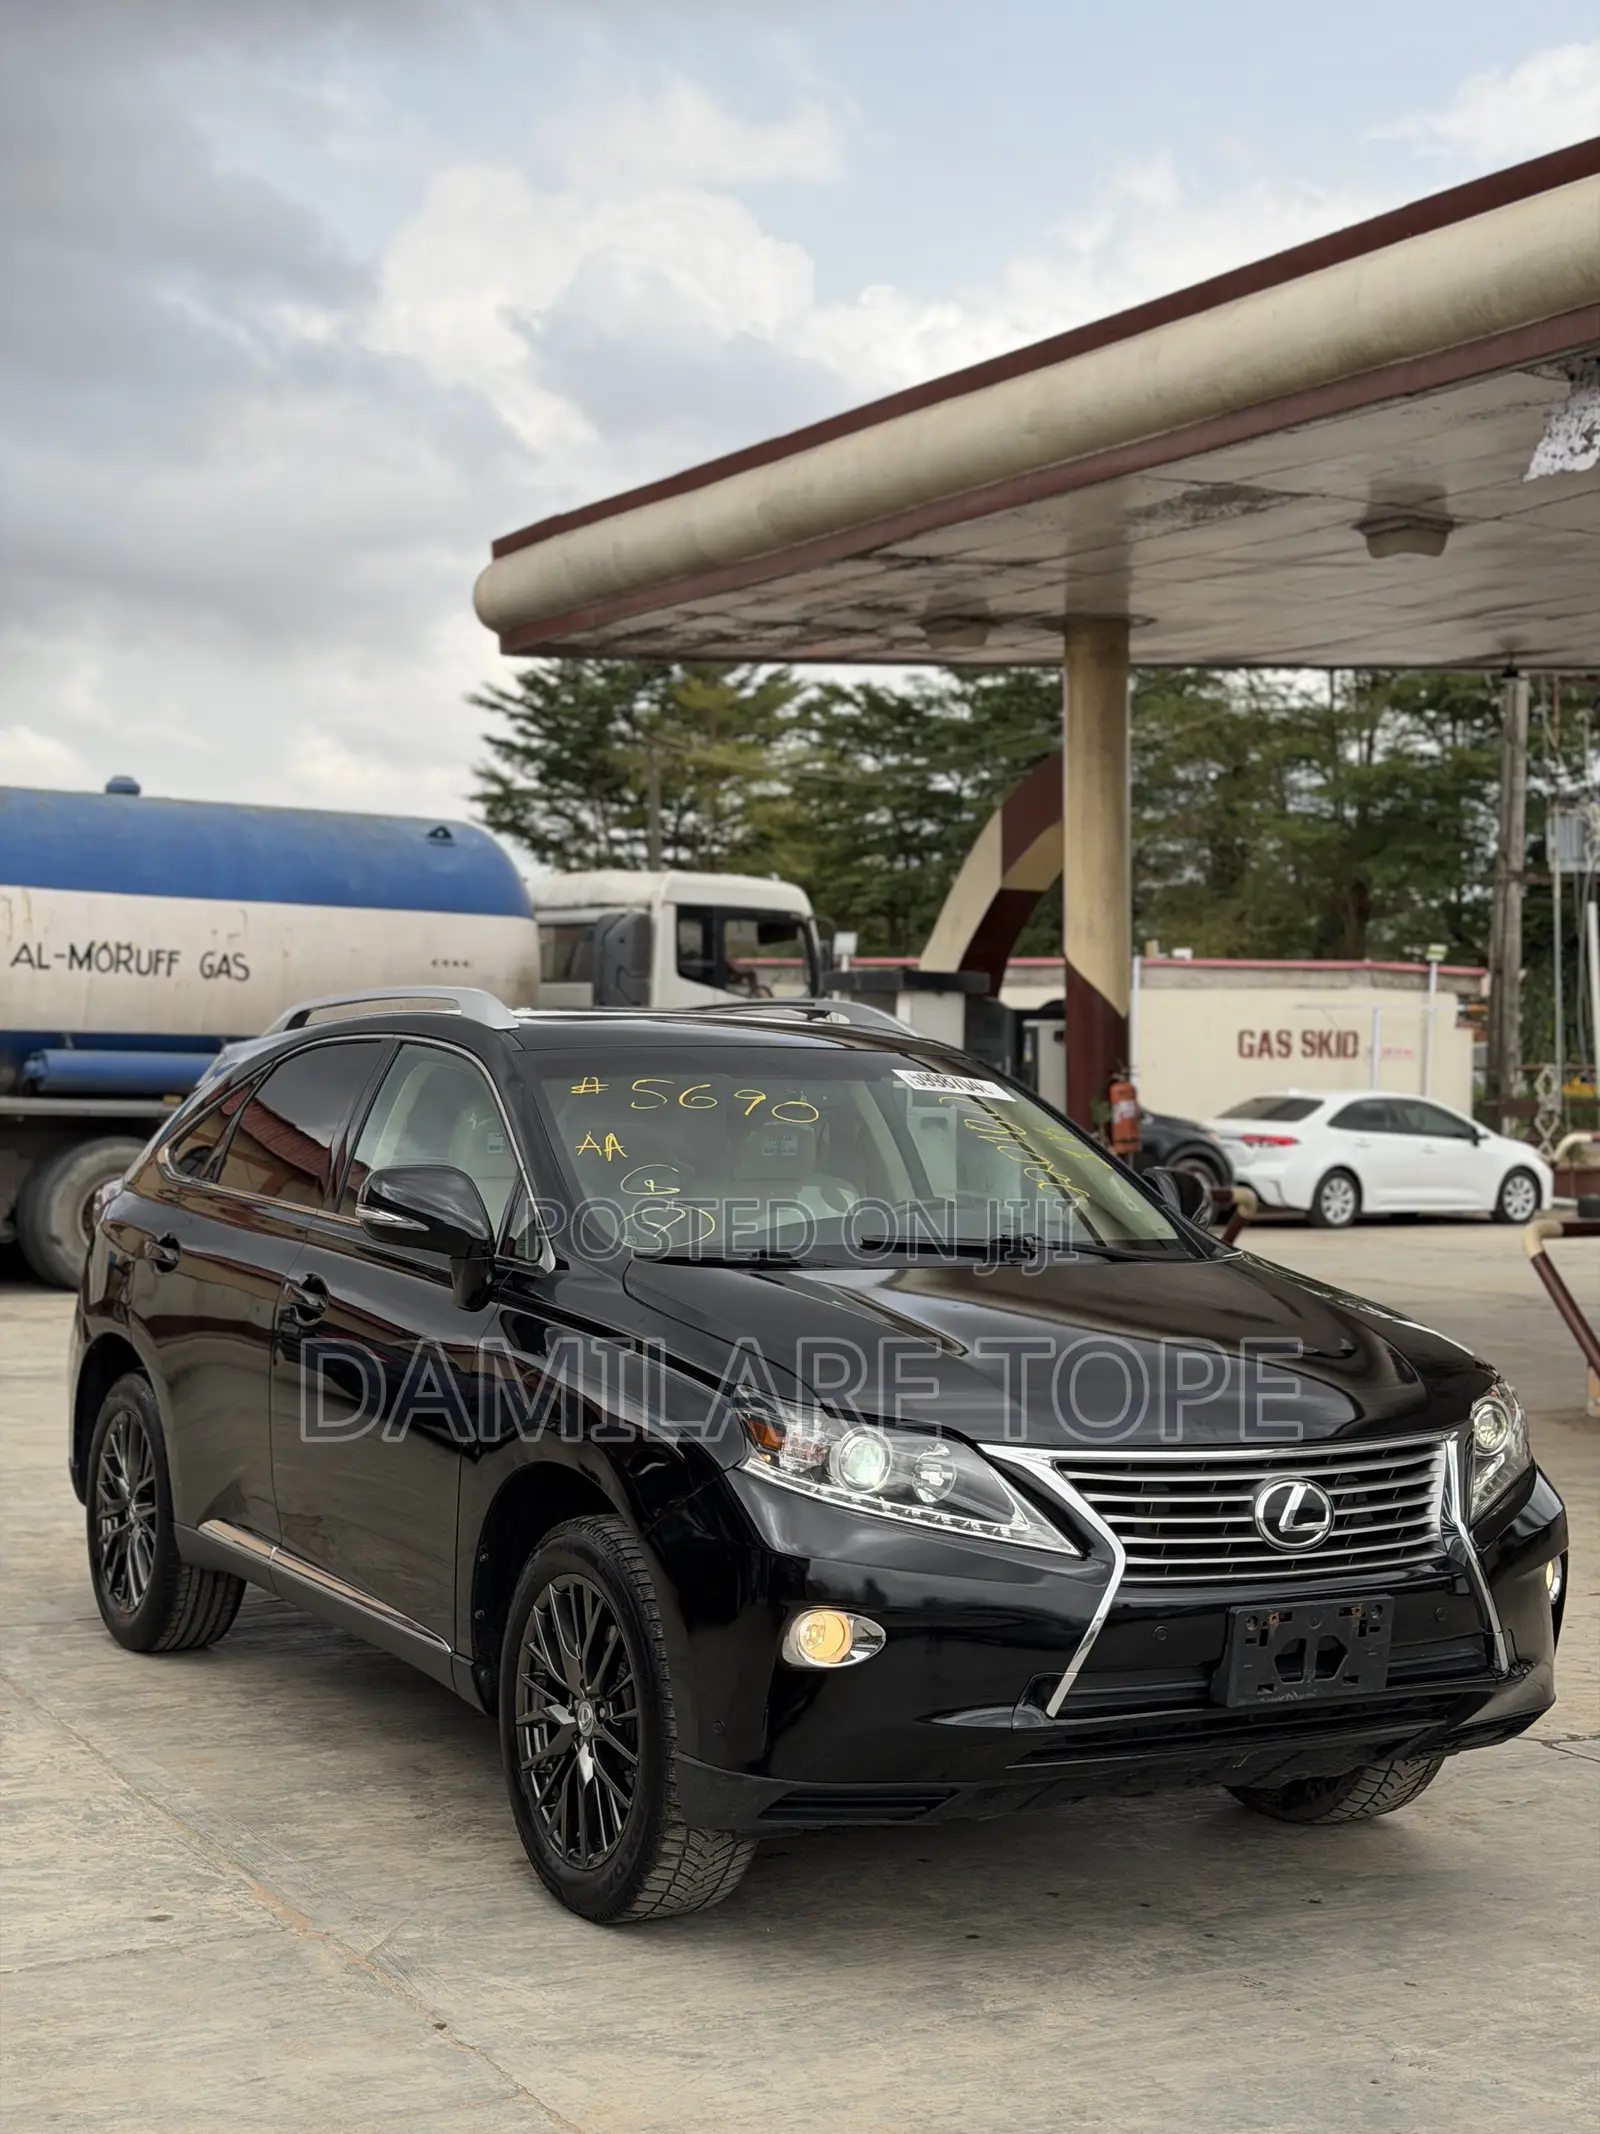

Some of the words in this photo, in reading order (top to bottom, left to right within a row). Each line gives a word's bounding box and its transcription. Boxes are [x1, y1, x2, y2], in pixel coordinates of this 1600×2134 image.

[10, 940, 181, 978] AL-MORUFF
[199, 951, 251, 982] GAS
[1237, 1029, 1293, 1060] GAS
[1300, 1029, 1360, 1060] SKID
